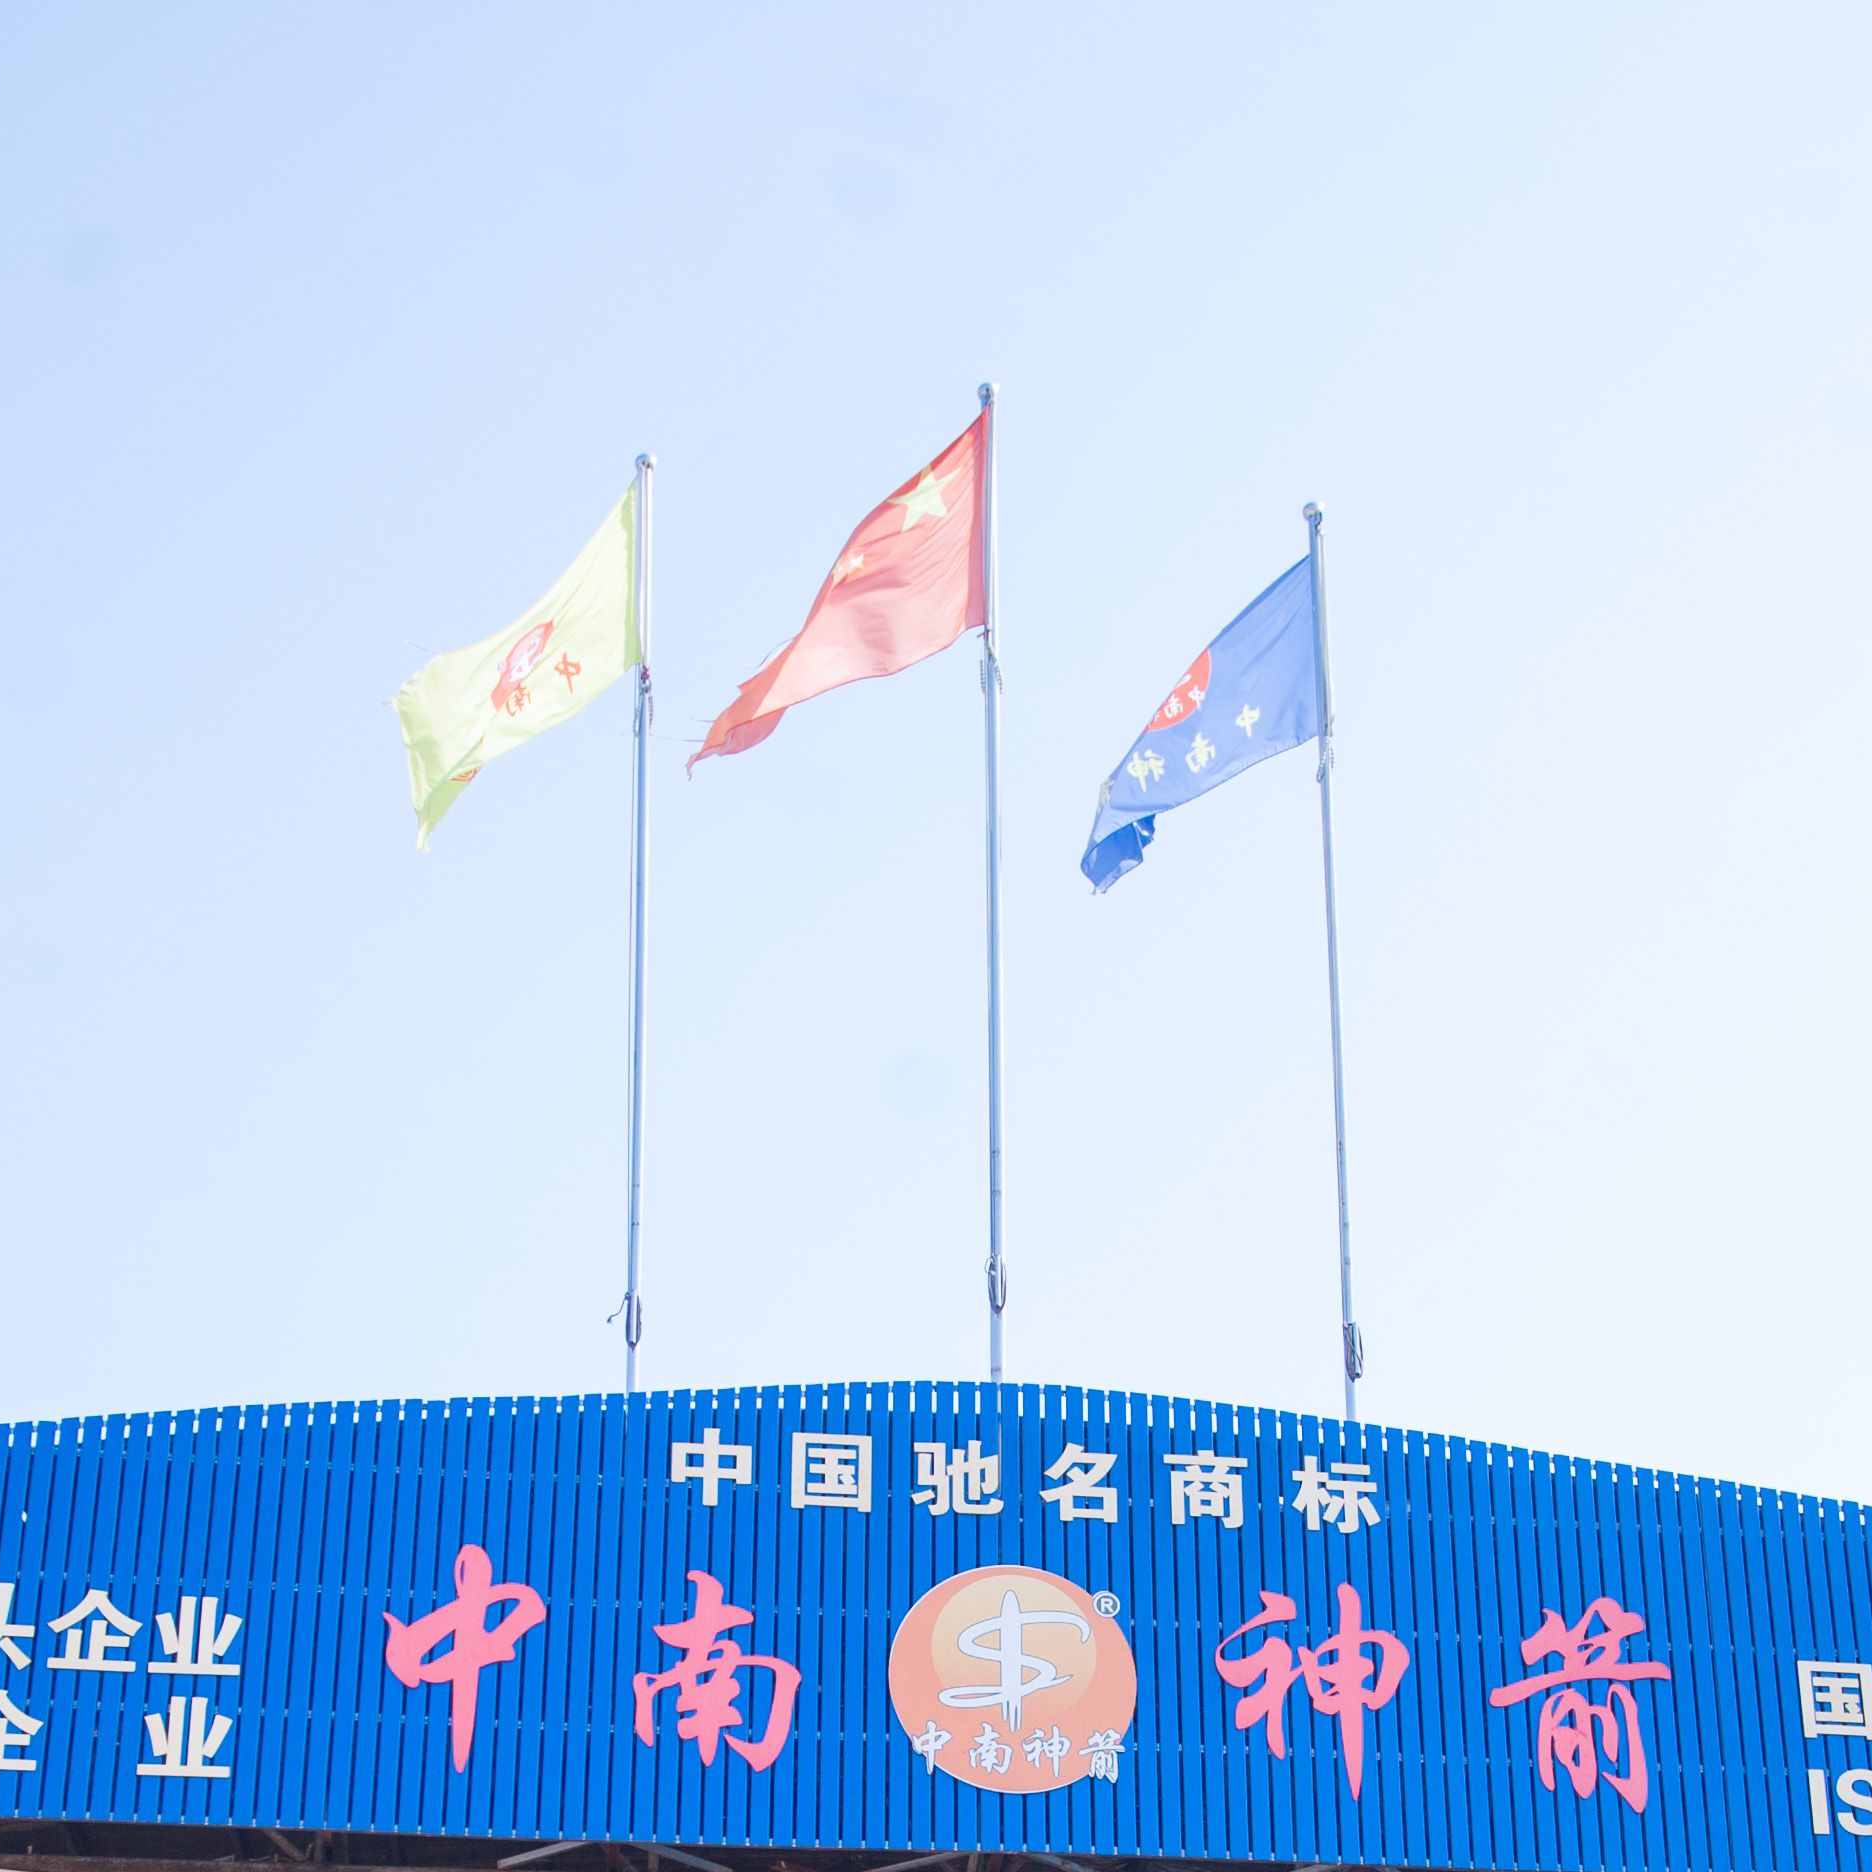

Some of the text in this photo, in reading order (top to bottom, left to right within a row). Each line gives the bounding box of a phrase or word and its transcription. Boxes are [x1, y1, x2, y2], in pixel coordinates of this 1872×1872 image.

[671, 1427, 1380, 1534] 中国驰名商标
[911, 1720, 1126, 1783] 中南神箭
